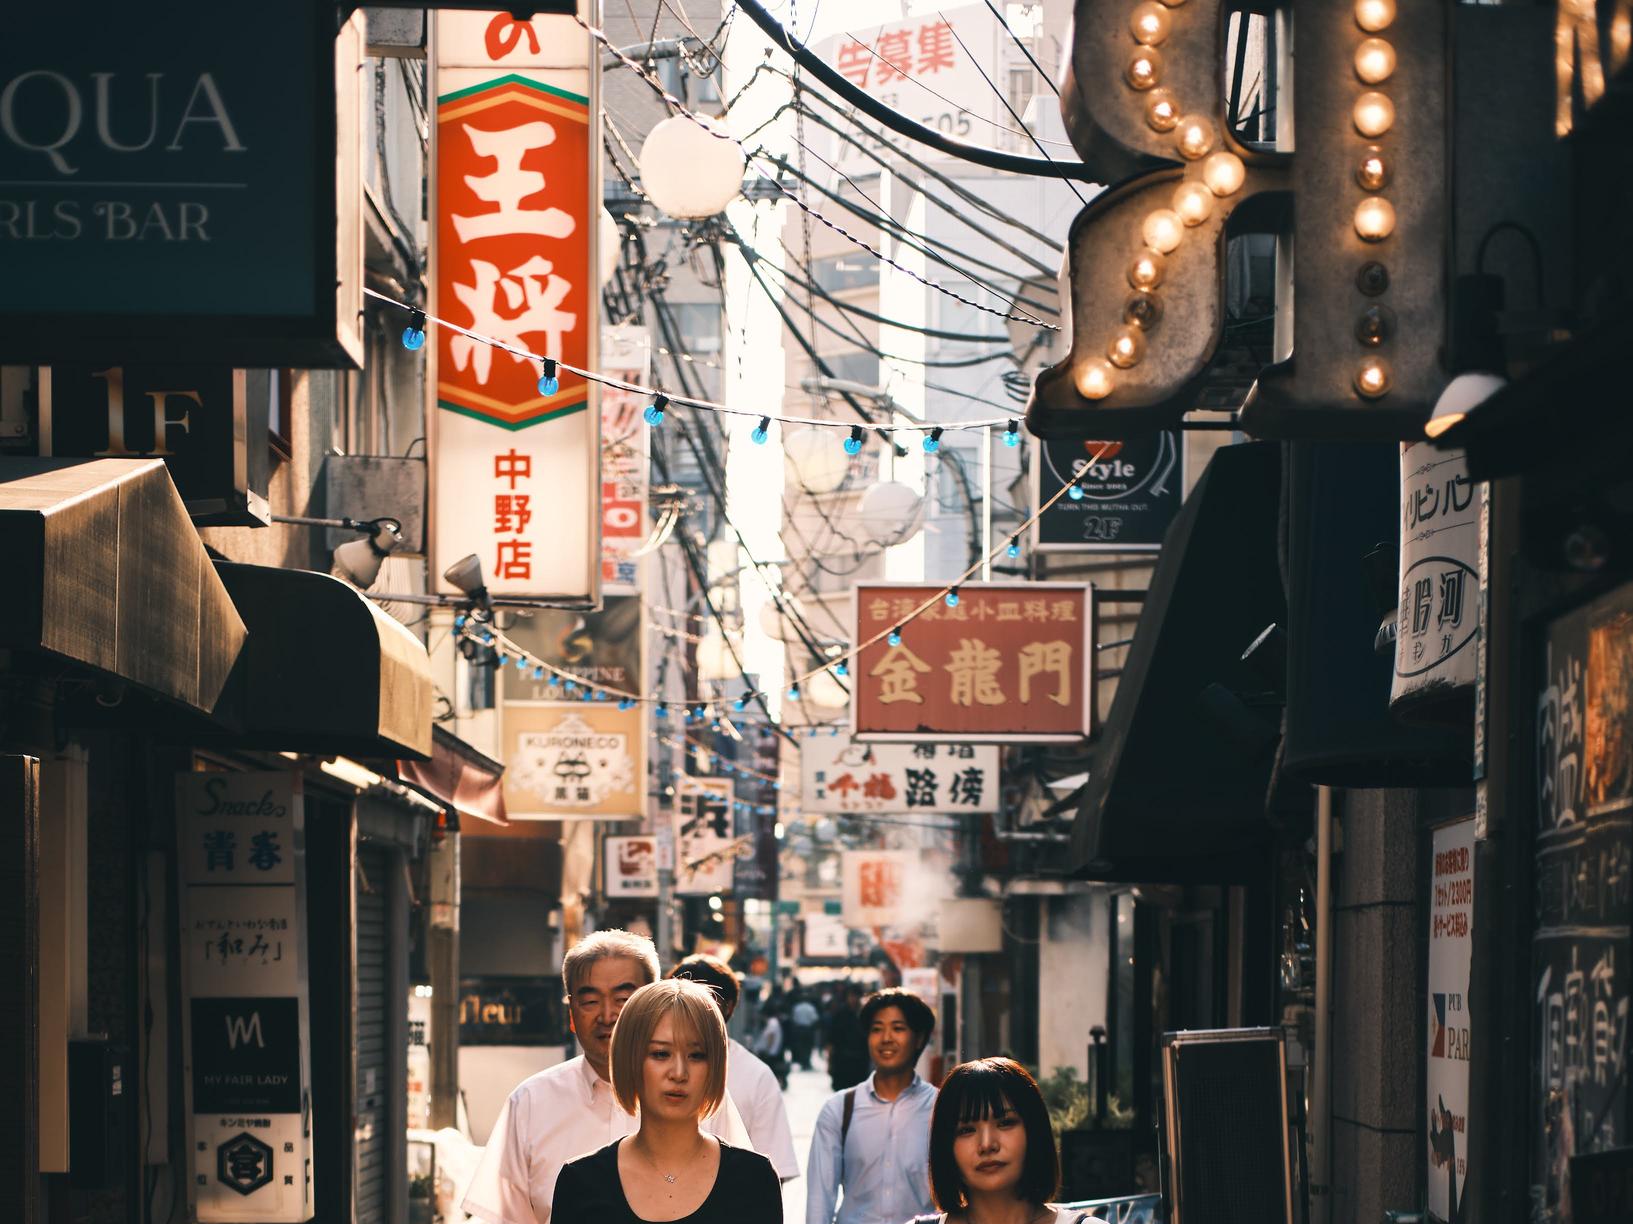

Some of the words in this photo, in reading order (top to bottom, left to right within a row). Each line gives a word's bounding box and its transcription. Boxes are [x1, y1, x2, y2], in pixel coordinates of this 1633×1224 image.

[0, 69, 247, 176] QUA
[93, 200, 212, 242] BAR
[449, 120, 578, 386] 王将
[91, 366, 205, 457] 1F
[1072, 459, 1135, 481] Style
[494, 449, 532, 582] 中野店
[1083, 515, 1123, 540] 2F
[868, 637, 1073, 708] 金龍門
[526, 736, 620, 750] KURONECO
[203, 831, 282, 872] 青春
[1448, 993, 1462, 1011] PUB
[204, 1076, 223, 1086] MY
[225, 1076, 253, 1086] FAIR
[257, 1075, 289, 1086] LADY
